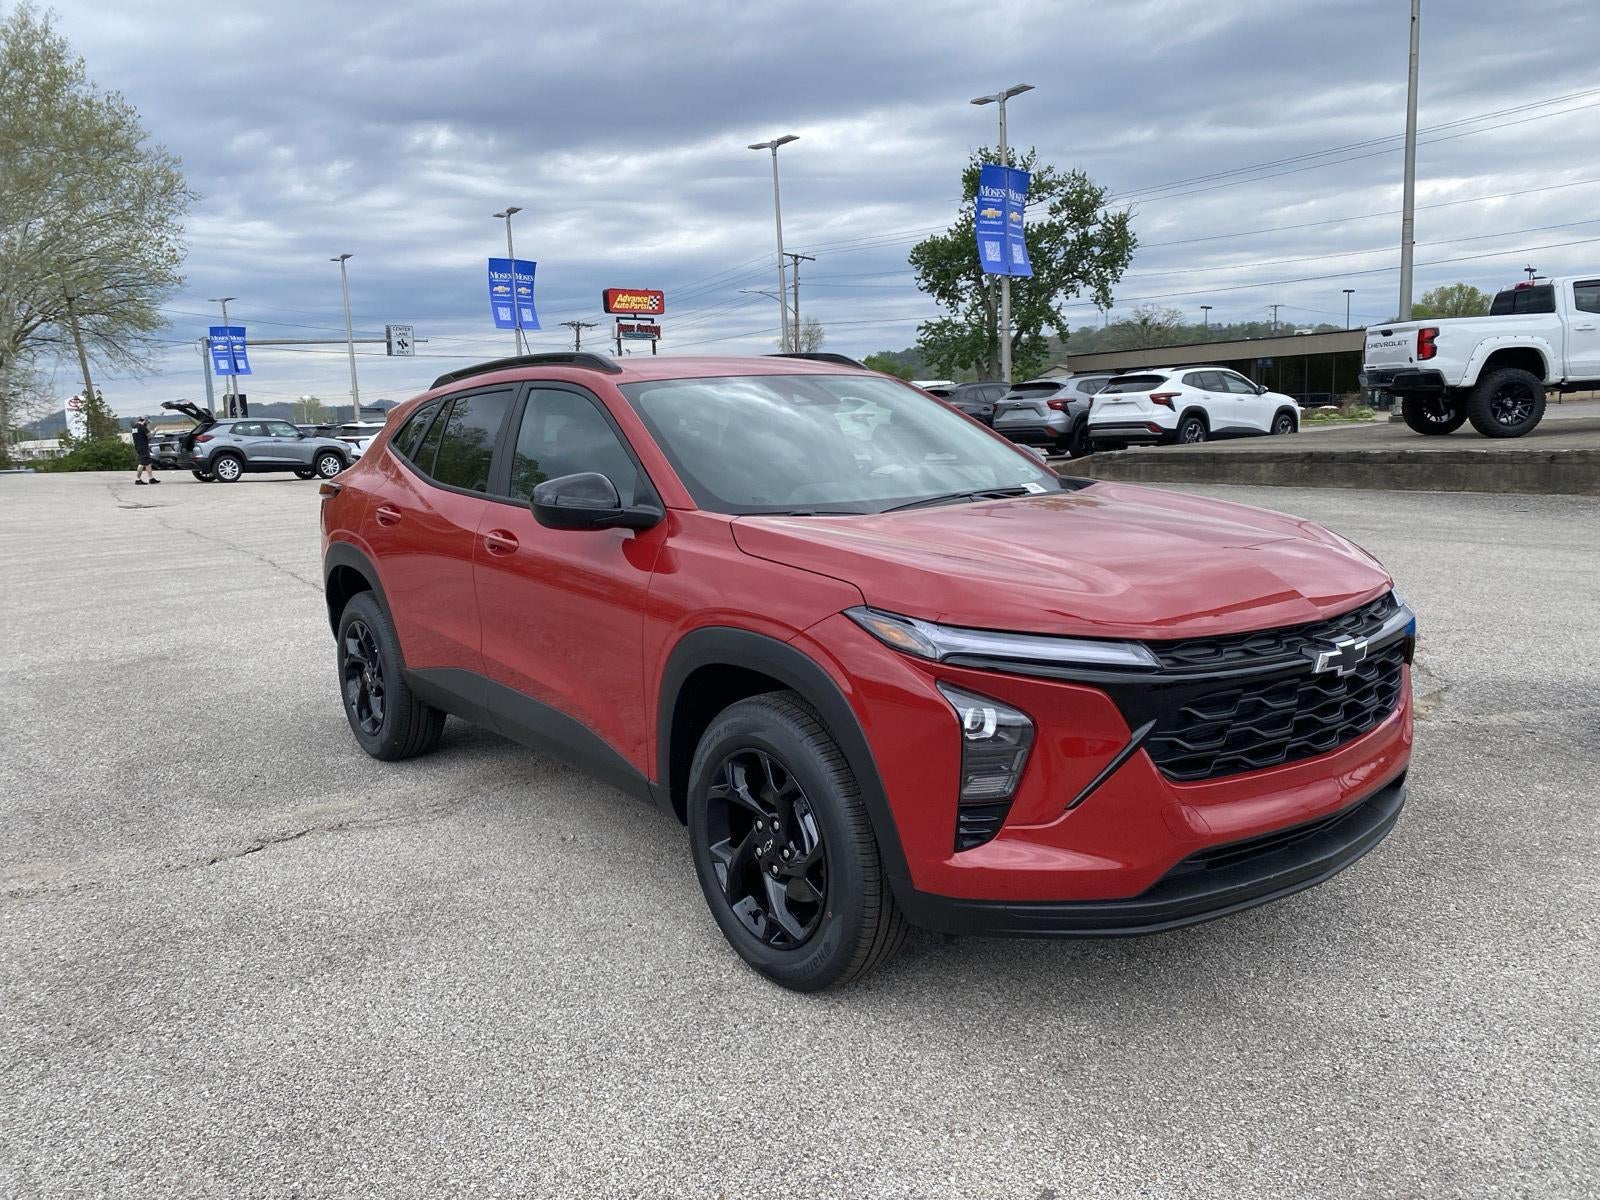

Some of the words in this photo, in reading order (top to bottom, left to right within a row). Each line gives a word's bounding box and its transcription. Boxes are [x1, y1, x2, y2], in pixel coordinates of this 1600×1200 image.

[980, 185, 1006, 198] MOSES
[616, 294, 648, 303] Advance
[612, 301, 630, 309] Auto
[629, 301, 648, 310] Parts
[1367, 340, 1408, 349] CHEVROLET
